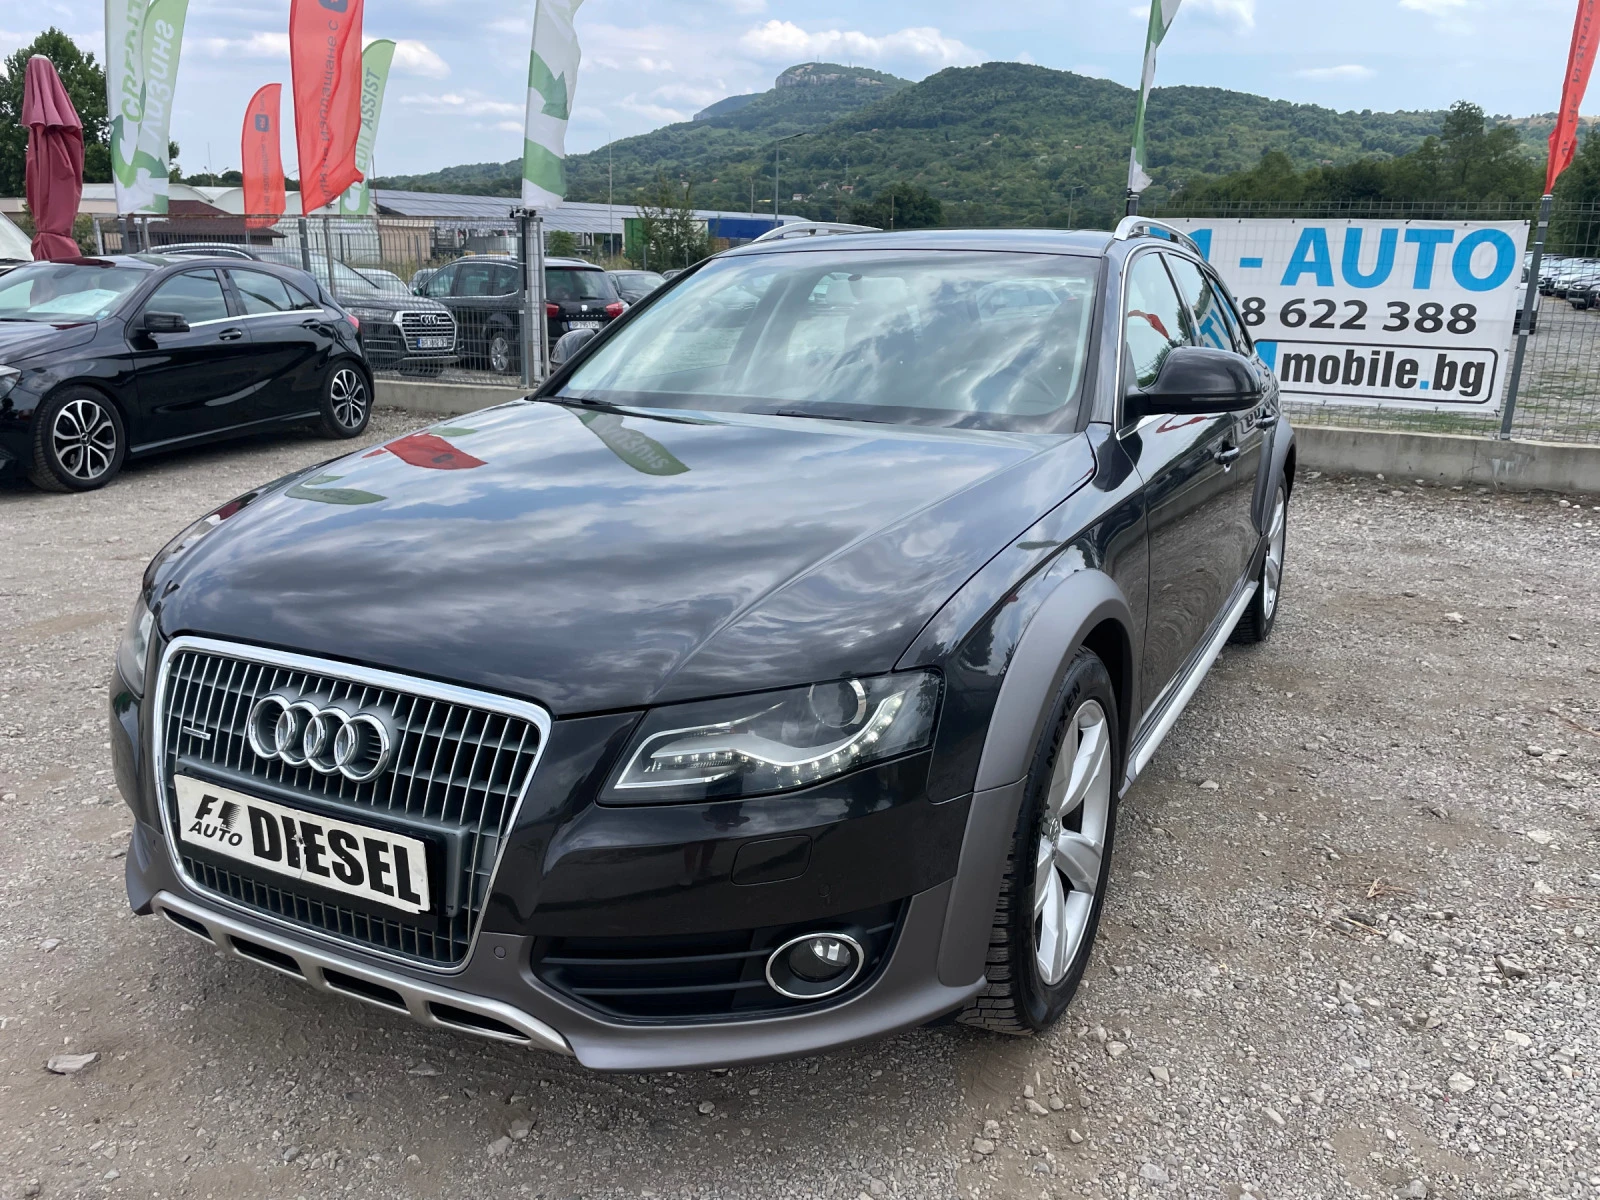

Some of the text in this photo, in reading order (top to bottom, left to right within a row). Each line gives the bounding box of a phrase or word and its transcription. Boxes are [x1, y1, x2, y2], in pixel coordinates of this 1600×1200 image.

[350, 67, 381, 193] CEDIT ASSIST
[1280, 227, 1516, 292] AUTO
[1279, 298, 1367, 330] 622
[1382, 301, 1477, 334] 388
[1280, 348, 1485, 396] mobile.bg
[1046, 681, 1081, 768] NEXEN
[188, 820, 243, 846] AUTO
[247, 805, 421, 906] DIESEL
